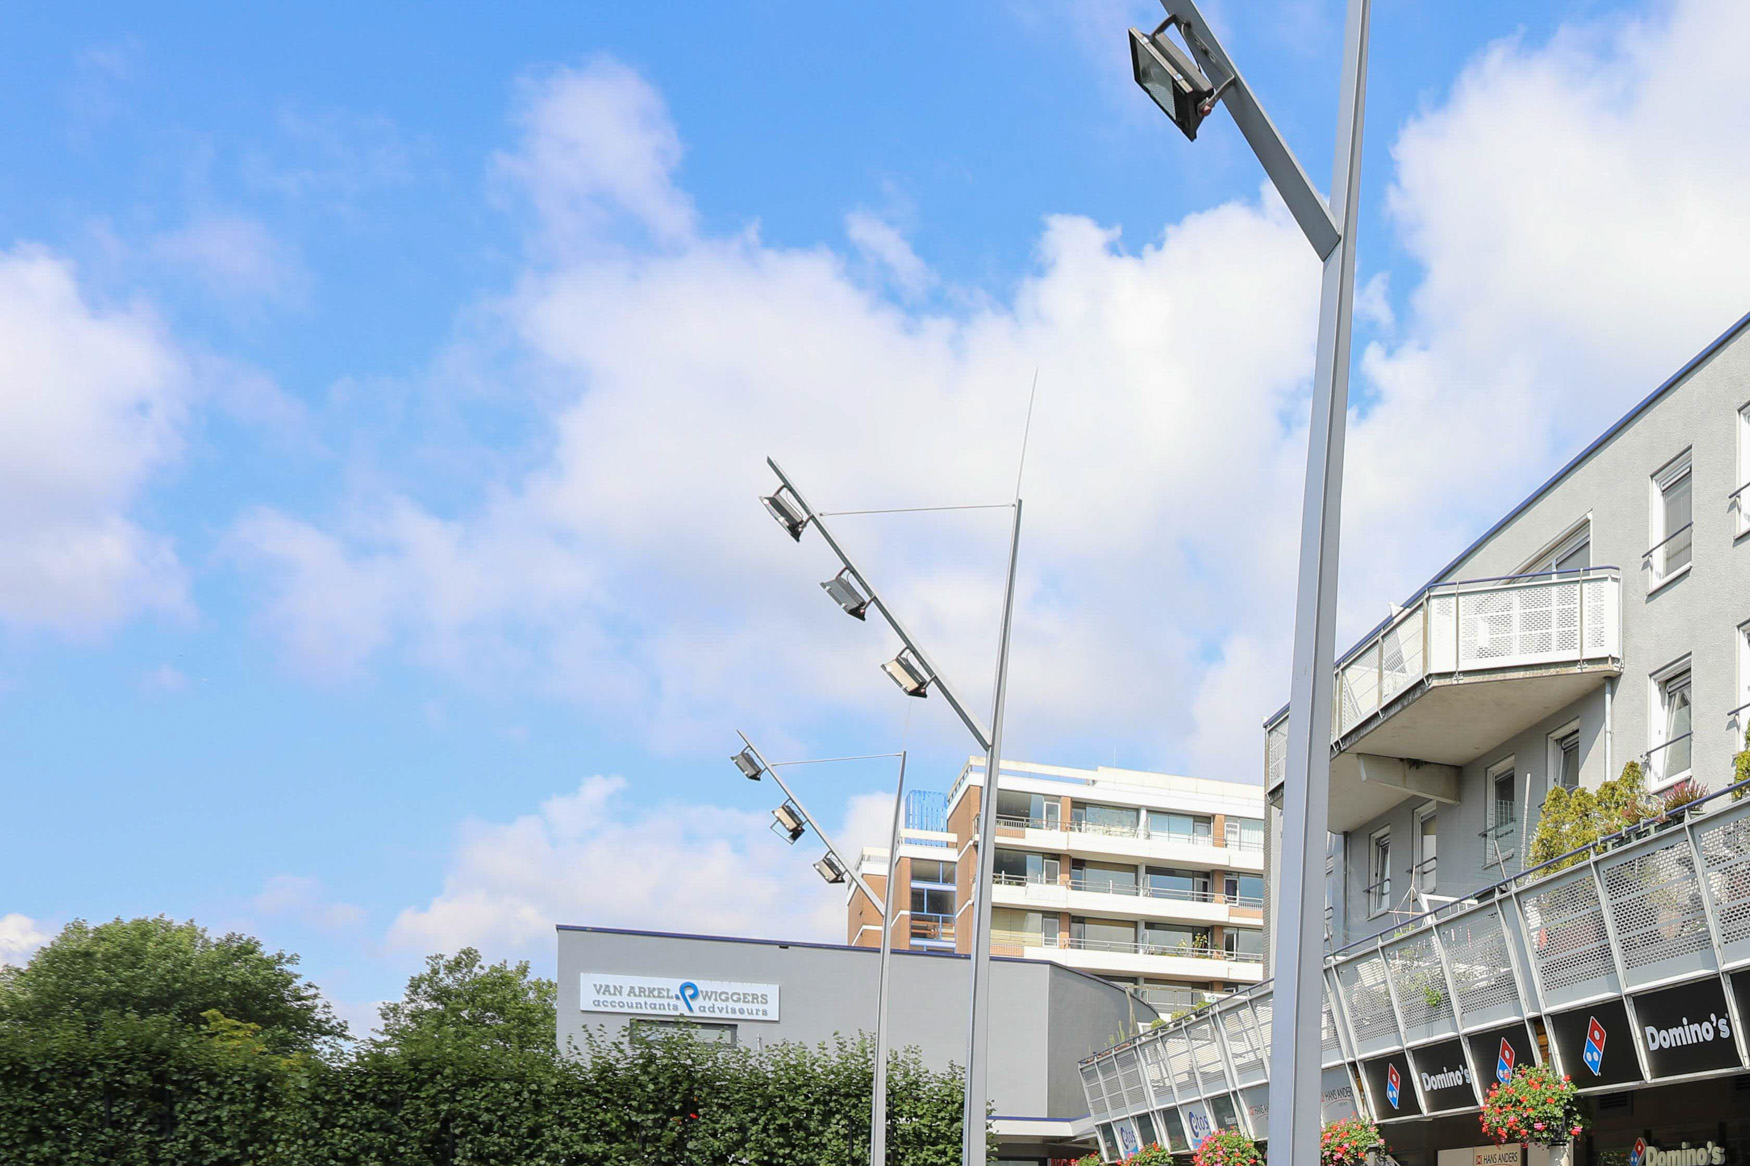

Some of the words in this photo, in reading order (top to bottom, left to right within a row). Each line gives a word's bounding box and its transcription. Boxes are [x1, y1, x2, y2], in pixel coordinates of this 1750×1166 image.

[593, 983, 622, 997] VAN
[627, 985, 675, 1000] ARKEL
[700, 989, 768, 1005] WIGGERS
[593, 999, 678, 1012] accountants
[698, 1003, 768, 1017] adviseurs
[1645, 1012, 1730, 1051] Domino's
[1421, 1064, 1471, 1092] Domino's
[1483, 1153, 1497, 1165] HANS
